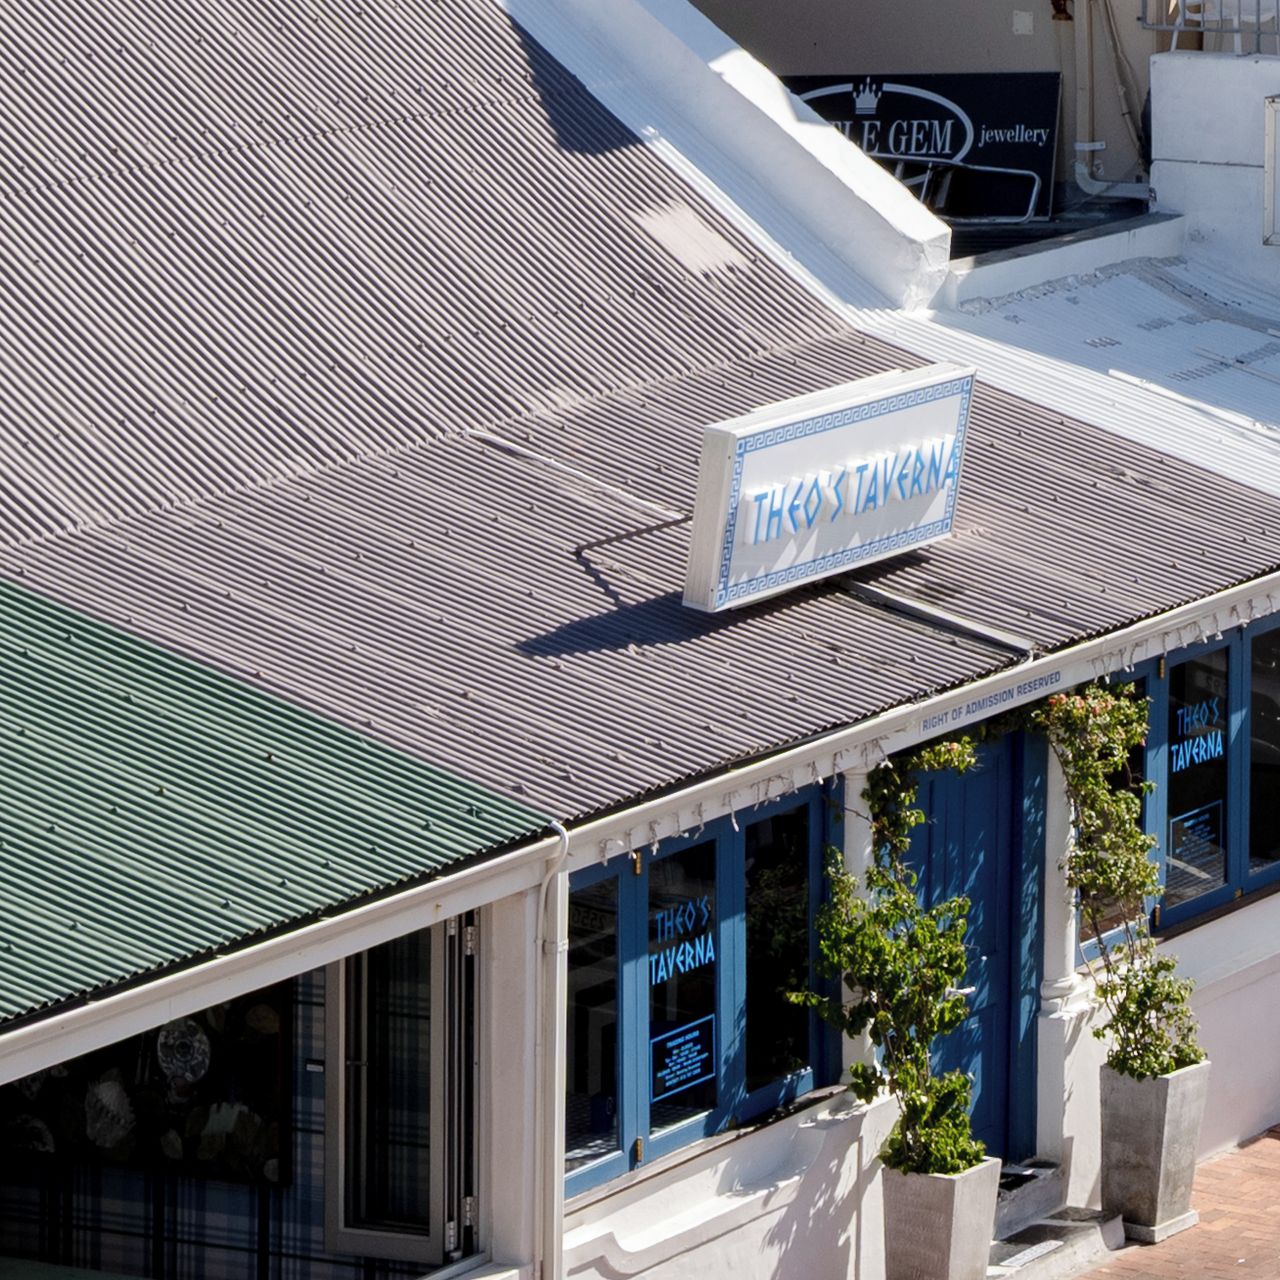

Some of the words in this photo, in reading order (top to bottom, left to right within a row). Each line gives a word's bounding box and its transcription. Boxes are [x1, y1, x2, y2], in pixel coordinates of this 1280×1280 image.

[888, 120, 955, 155] GEM
[978, 124, 1051, 148] jewellery
[753, 469, 848, 546] THEO'S
[855, 437, 958, 516] TAVERNA
[922, 711, 949, 732] RIGHT
[951, 706, 963, 721] OF
[965, 688, 1014, 716] ADMISSION
[1016, 671, 1061, 696] RESERVED
[1177, 696, 1219, 736] THEO'S
[1171, 729, 1223, 773] TAVERNA
[656, 895, 710, 943] THEO'S
[650, 932, 715, 986] TAVERNA
